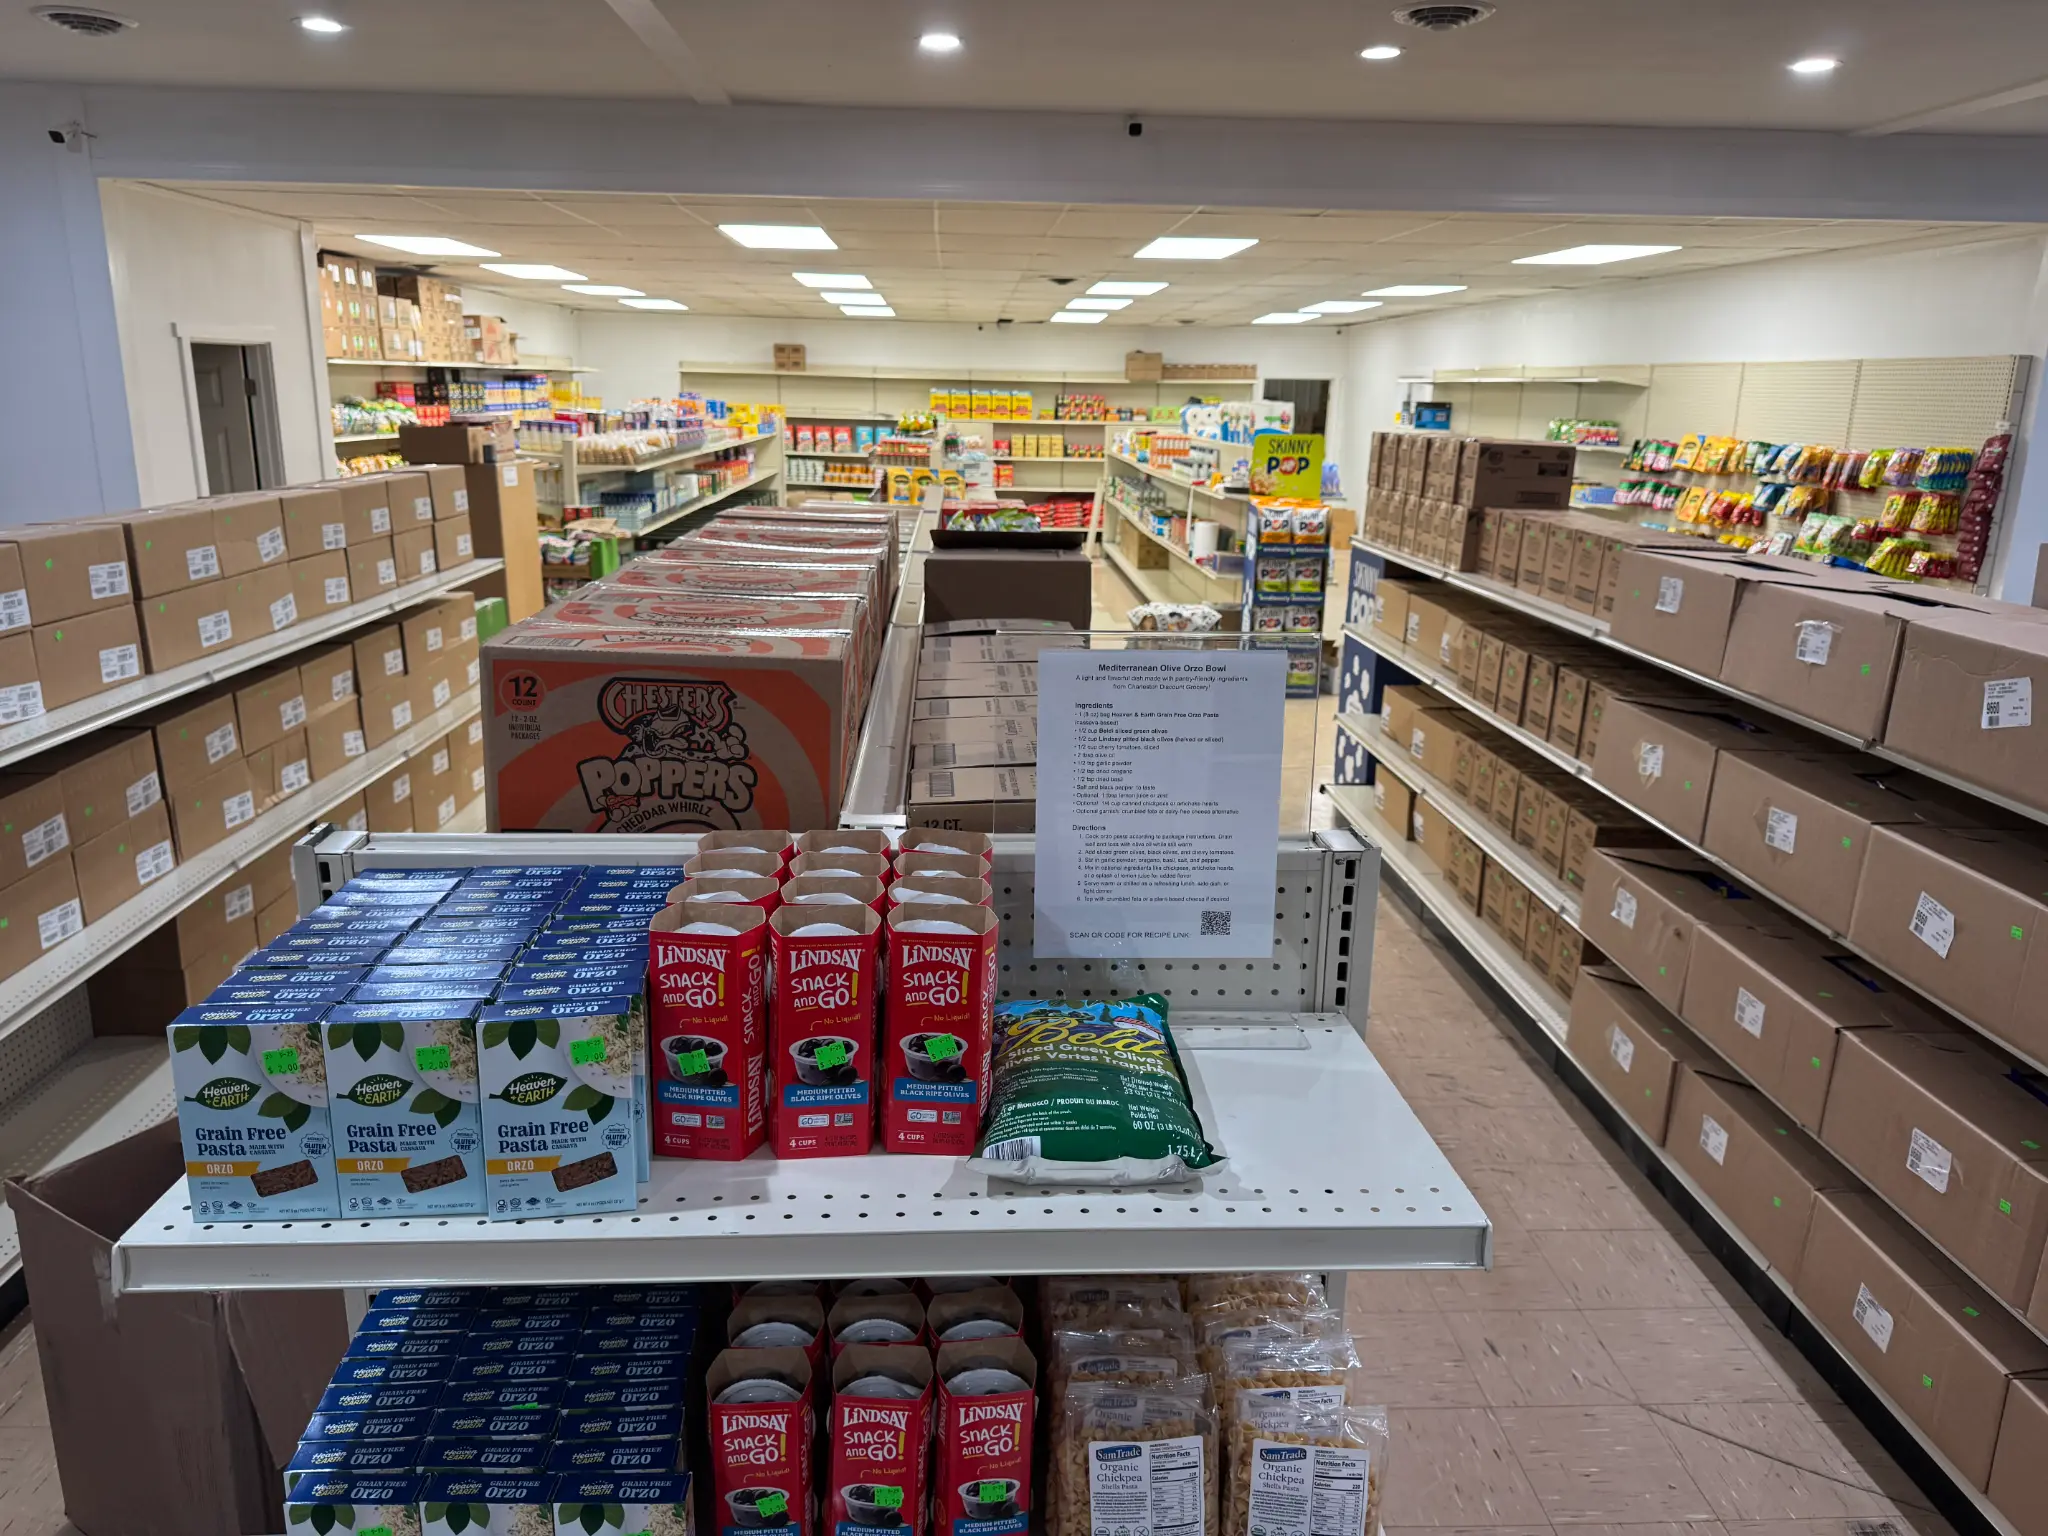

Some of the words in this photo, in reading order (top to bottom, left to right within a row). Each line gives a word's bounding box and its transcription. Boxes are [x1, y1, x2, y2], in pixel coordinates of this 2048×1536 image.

[1268, 438, 1313, 454] SKINNY
[1267, 456, 1310, 476] POP
[1264, 520, 1289, 530] POP
[1300, 522, 1324, 532] POP
[1098, 664, 1158, 672] Mediterranean
[1160, 664, 1181, 672] Olive
[1184, 664, 1204, 672] Orzo
[1206, 664, 1226, 672] Bowl
[508, 676, 538, 697] 12
[608, 681, 726, 726] CHESTER'S
[1075, 702, 1114, 710] Ingredients
[508, 723, 542, 732] INDIVIDUAL
[510, 732, 541, 740] PACKAGES
[578, 756, 758, 814] POPPERS
[616, 806, 666, 832] CHEDDAR
[669, 802, 714, 818] WHIRLZ
[657, 946, 727, 972] LINDSAY
[790, 948, 861, 974] LINDSAY
[902, 946, 972, 970] LINDSAY
[660, 972, 716, 989] SNACK
[791, 972, 849, 994] SNACK
[903, 970, 960, 988] SNACK
[663, 993, 685, 1003] AND
[794, 996, 817, 1008] AND
[905, 992, 926, 1002] AND
[551, 1005, 599, 1015] Orzo
[585, 1052, 604, 1062] 2.00
[1008, 1044, 1054, 1060] Sliced
[1060, 1043, 1108, 1056] Green
[1114, 1050, 1164, 1066] Olives
[1046, 1052, 1096, 1064] Vertes
[278, 1062, 298, 1074] 2.00
[428, 1060, 448, 1070] 2.00
[203, 1084, 250, 1098] Heaven
[356, 1080, 402, 1095] Heaven
[508, 1078, 556, 1094] Heaven
[669, 1086, 698, 1094] MEDIUM
[700, 1088, 726, 1096] PITTED
[664, 1092, 687, 1100] BLACK
[791, 1094, 814, 1102] BLACK
[1017, 1100, 1049, 1110] MOROCCO
[346, 1123, 394, 1138] Grain
[398, 1124, 436, 1137] Free
[498, 1122, 546, 1138] Grain
[550, 1120, 589, 1135] Free
[1132, 1121, 1144, 1130] 60
[1145, 1121, 1155, 1130] OZ
[196, 1126, 244, 1141] Grain
[247, 1127, 286, 1140] Free
[898, 1132, 905, 1140] 4
[348, 1139, 397, 1153] Pasta
[498, 1138, 548, 1154] Pasta
[664, 1136, 670, 1144] 4
[789, 1139, 796, 1147] 4
[198, 1142, 247, 1156] Pasta
[304, 1143, 326, 1151] GLUTEN
[206, 1164, 234, 1174] ORZO
[357, 1160, 384, 1171] ORZO
[507, 1160, 534, 1172] ORZO
[844, 1407, 909, 1432] LINDSAY
[959, 1402, 1023, 1427] LINDSAY
[721, 1414, 788, 1435] LINDSAY
[844, 1430, 896, 1444] SNACK
[960, 1424, 1013, 1444] SNACK
[724, 1434, 778, 1452] SNACK
[846, 1448, 866, 1457] AND
[962, 1446, 983, 1456] AND
[1098, 1448, 1140, 1460] SamTrade
[1152, 1452, 1176, 1460] Nutrition
[1261, 1449, 1306, 1460] SamTrade
[727, 1454, 748, 1464] AND
[1316, 1460, 1341, 1468] Nutrition
[1100, 1463, 1139, 1474] Organic
[1263, 1462, 1302, 1474] Organic
[1096, 1474, 1142, 1484] Chickpea
[1258, 1472, 1304, 1485] Chickpea
[485, 1486, 528, 1498] Orzo
[1262, 1482, 1281, 1490] Shells
[351, 1487, 394, 1499] Orzo
[619, 1487, 660, 1498] Orzo
